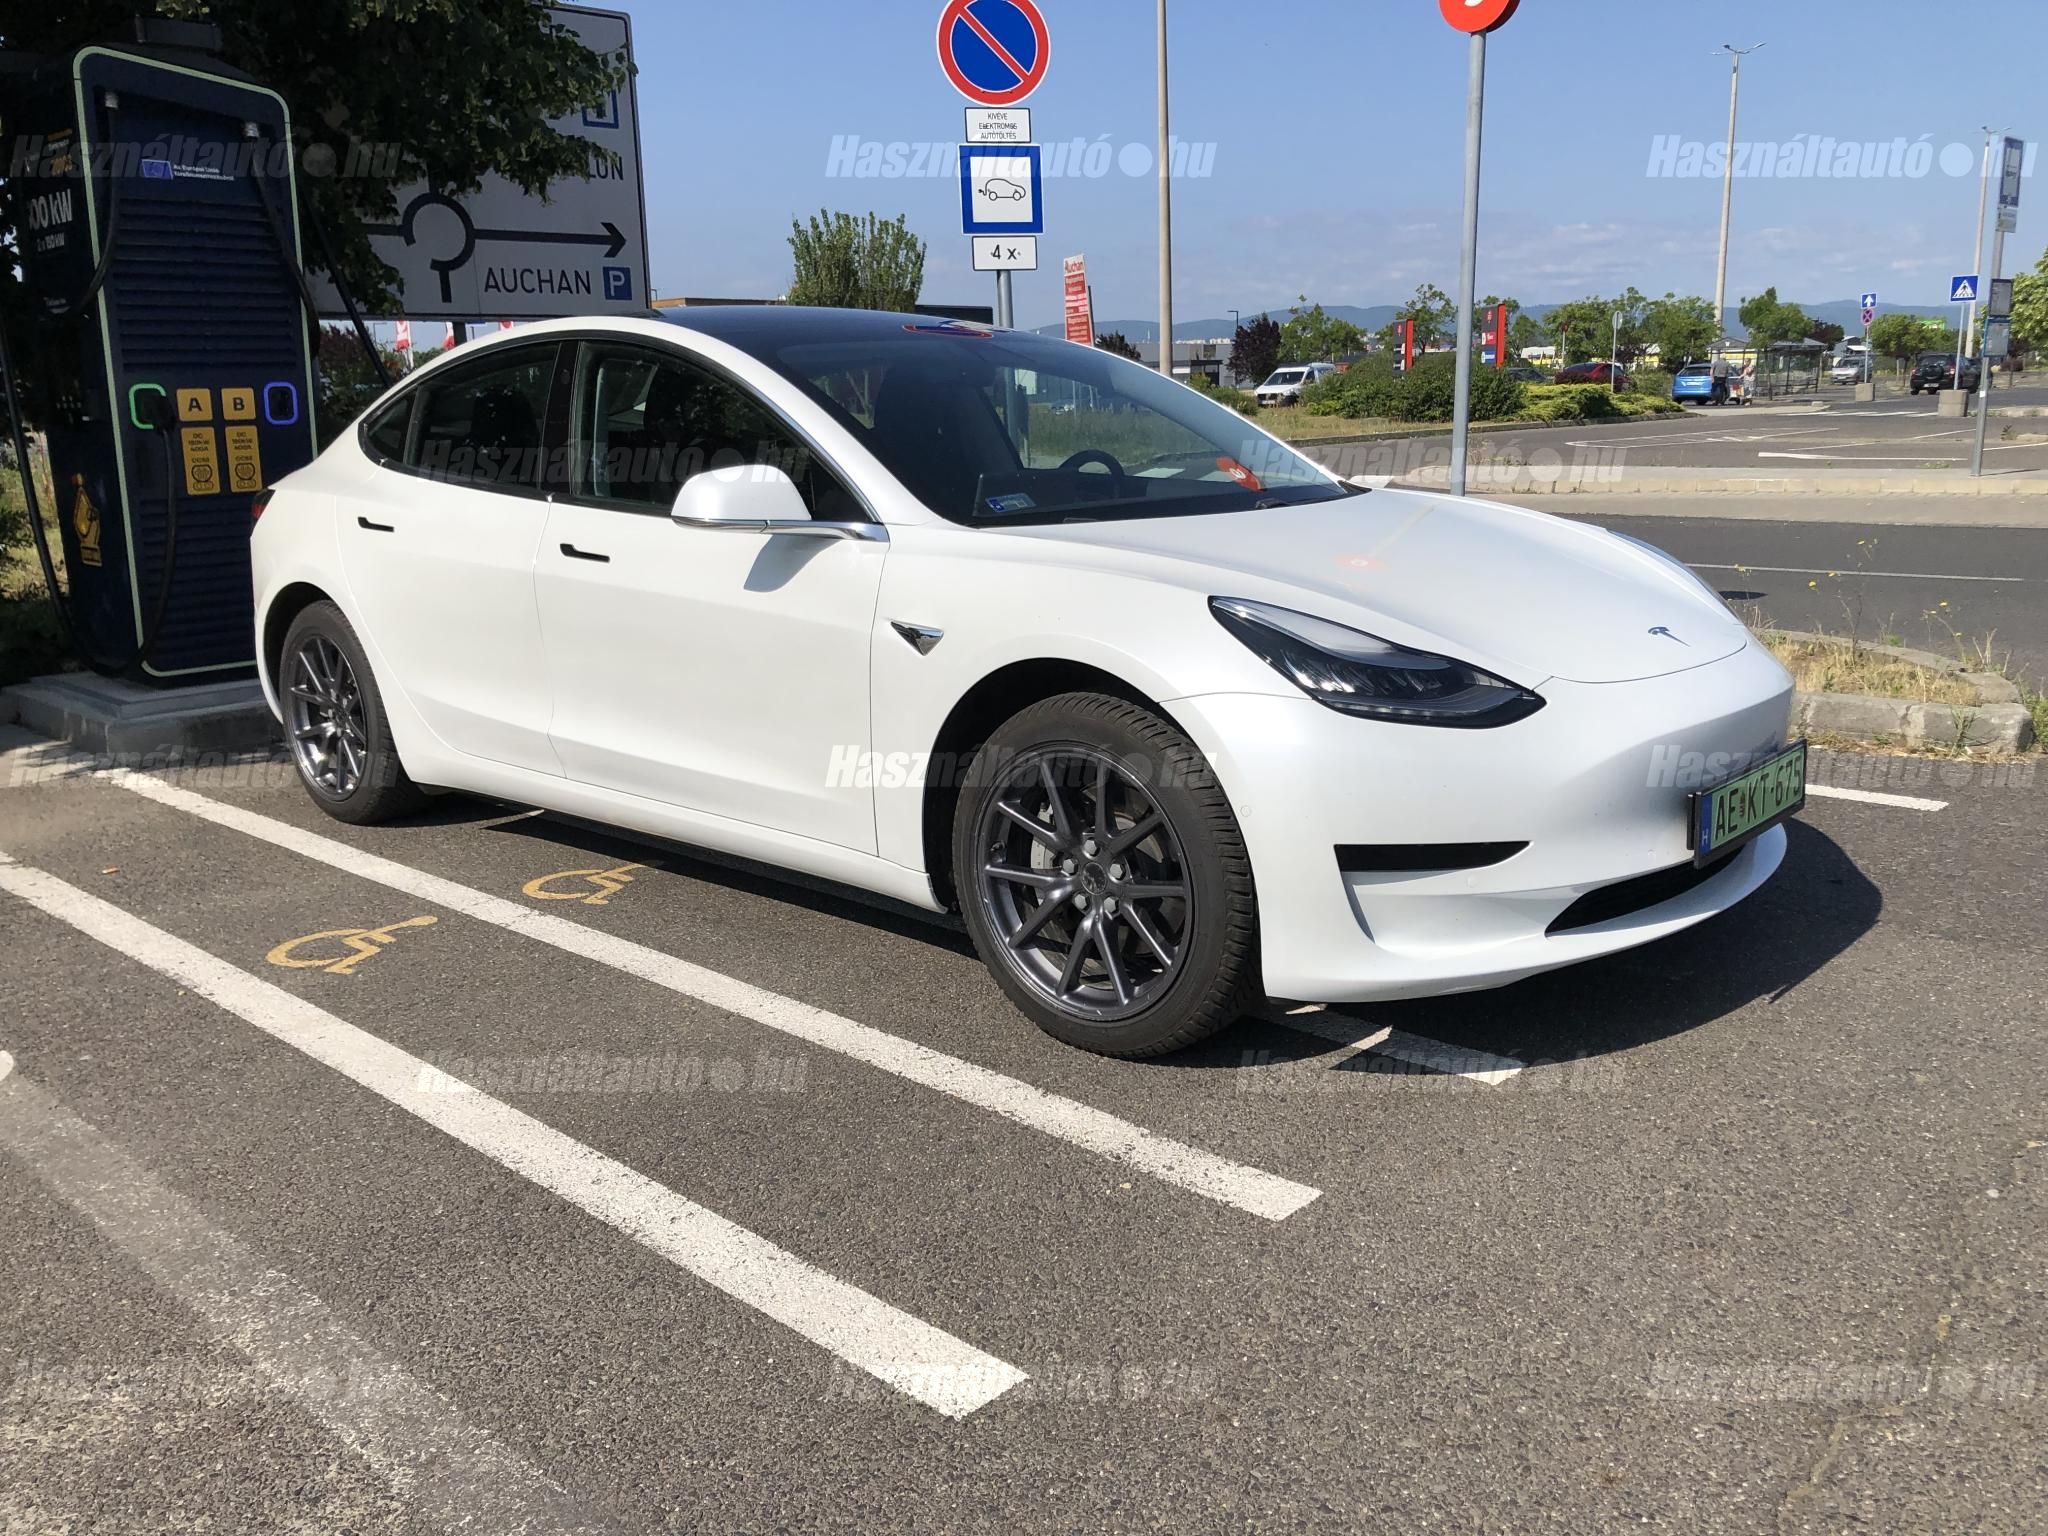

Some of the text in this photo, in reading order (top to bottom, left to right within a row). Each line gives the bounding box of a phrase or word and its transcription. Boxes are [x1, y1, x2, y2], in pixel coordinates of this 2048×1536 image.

[987, 111, 1008, 121] KIVÉVE
[992, 245, 1001, 260] 4
[484, 267, 625, 296] AUCHAN P
[188, 398, 202, 412] A
[233, 397, 245, 411] B
[1715, 755, 1803, 841] AE KT-675
[1701, 829, 1709, 846] H
